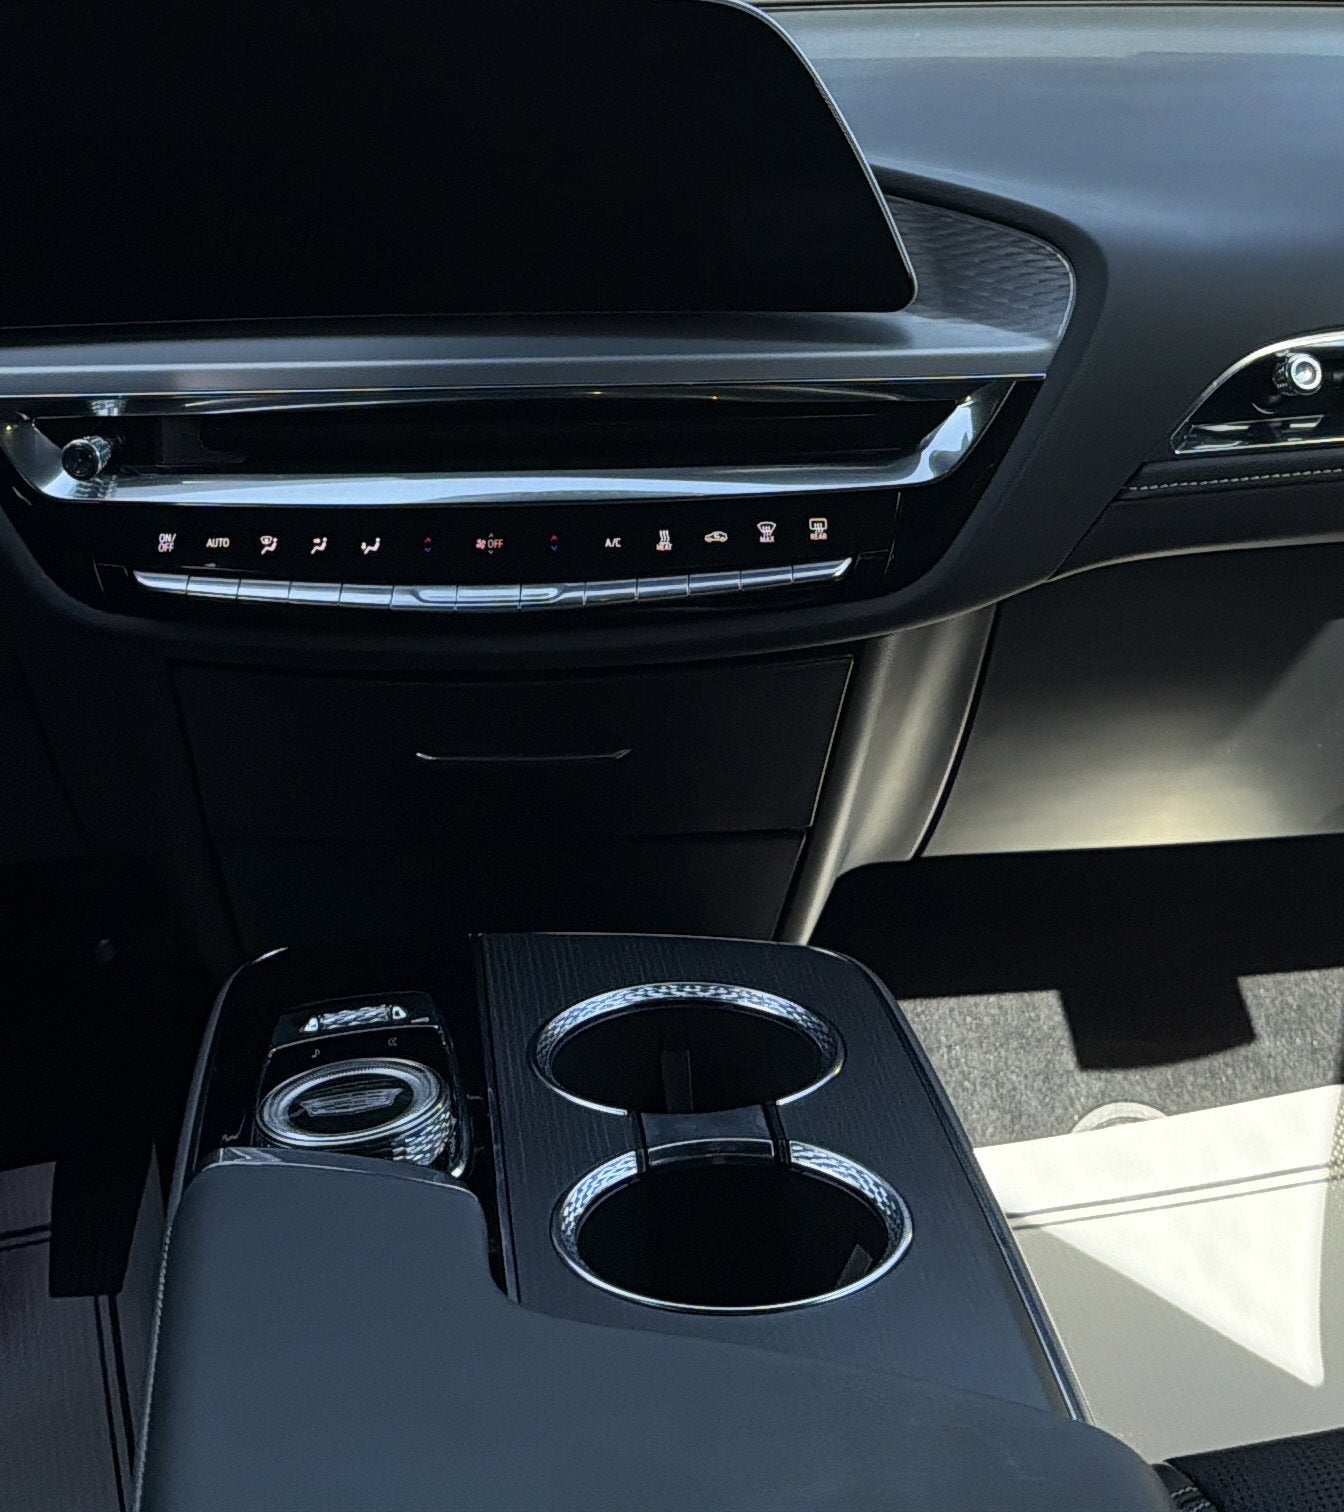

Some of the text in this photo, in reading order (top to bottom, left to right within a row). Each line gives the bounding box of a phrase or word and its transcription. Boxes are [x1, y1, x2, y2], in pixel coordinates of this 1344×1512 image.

[158, 533, 176, 544] ON/
[206, 537, 230, 548] AUTO
[487, 538, 504, 549] OFF
[604, 537, 622, 548] A/C
[158, 543, 175, 553] OFF
